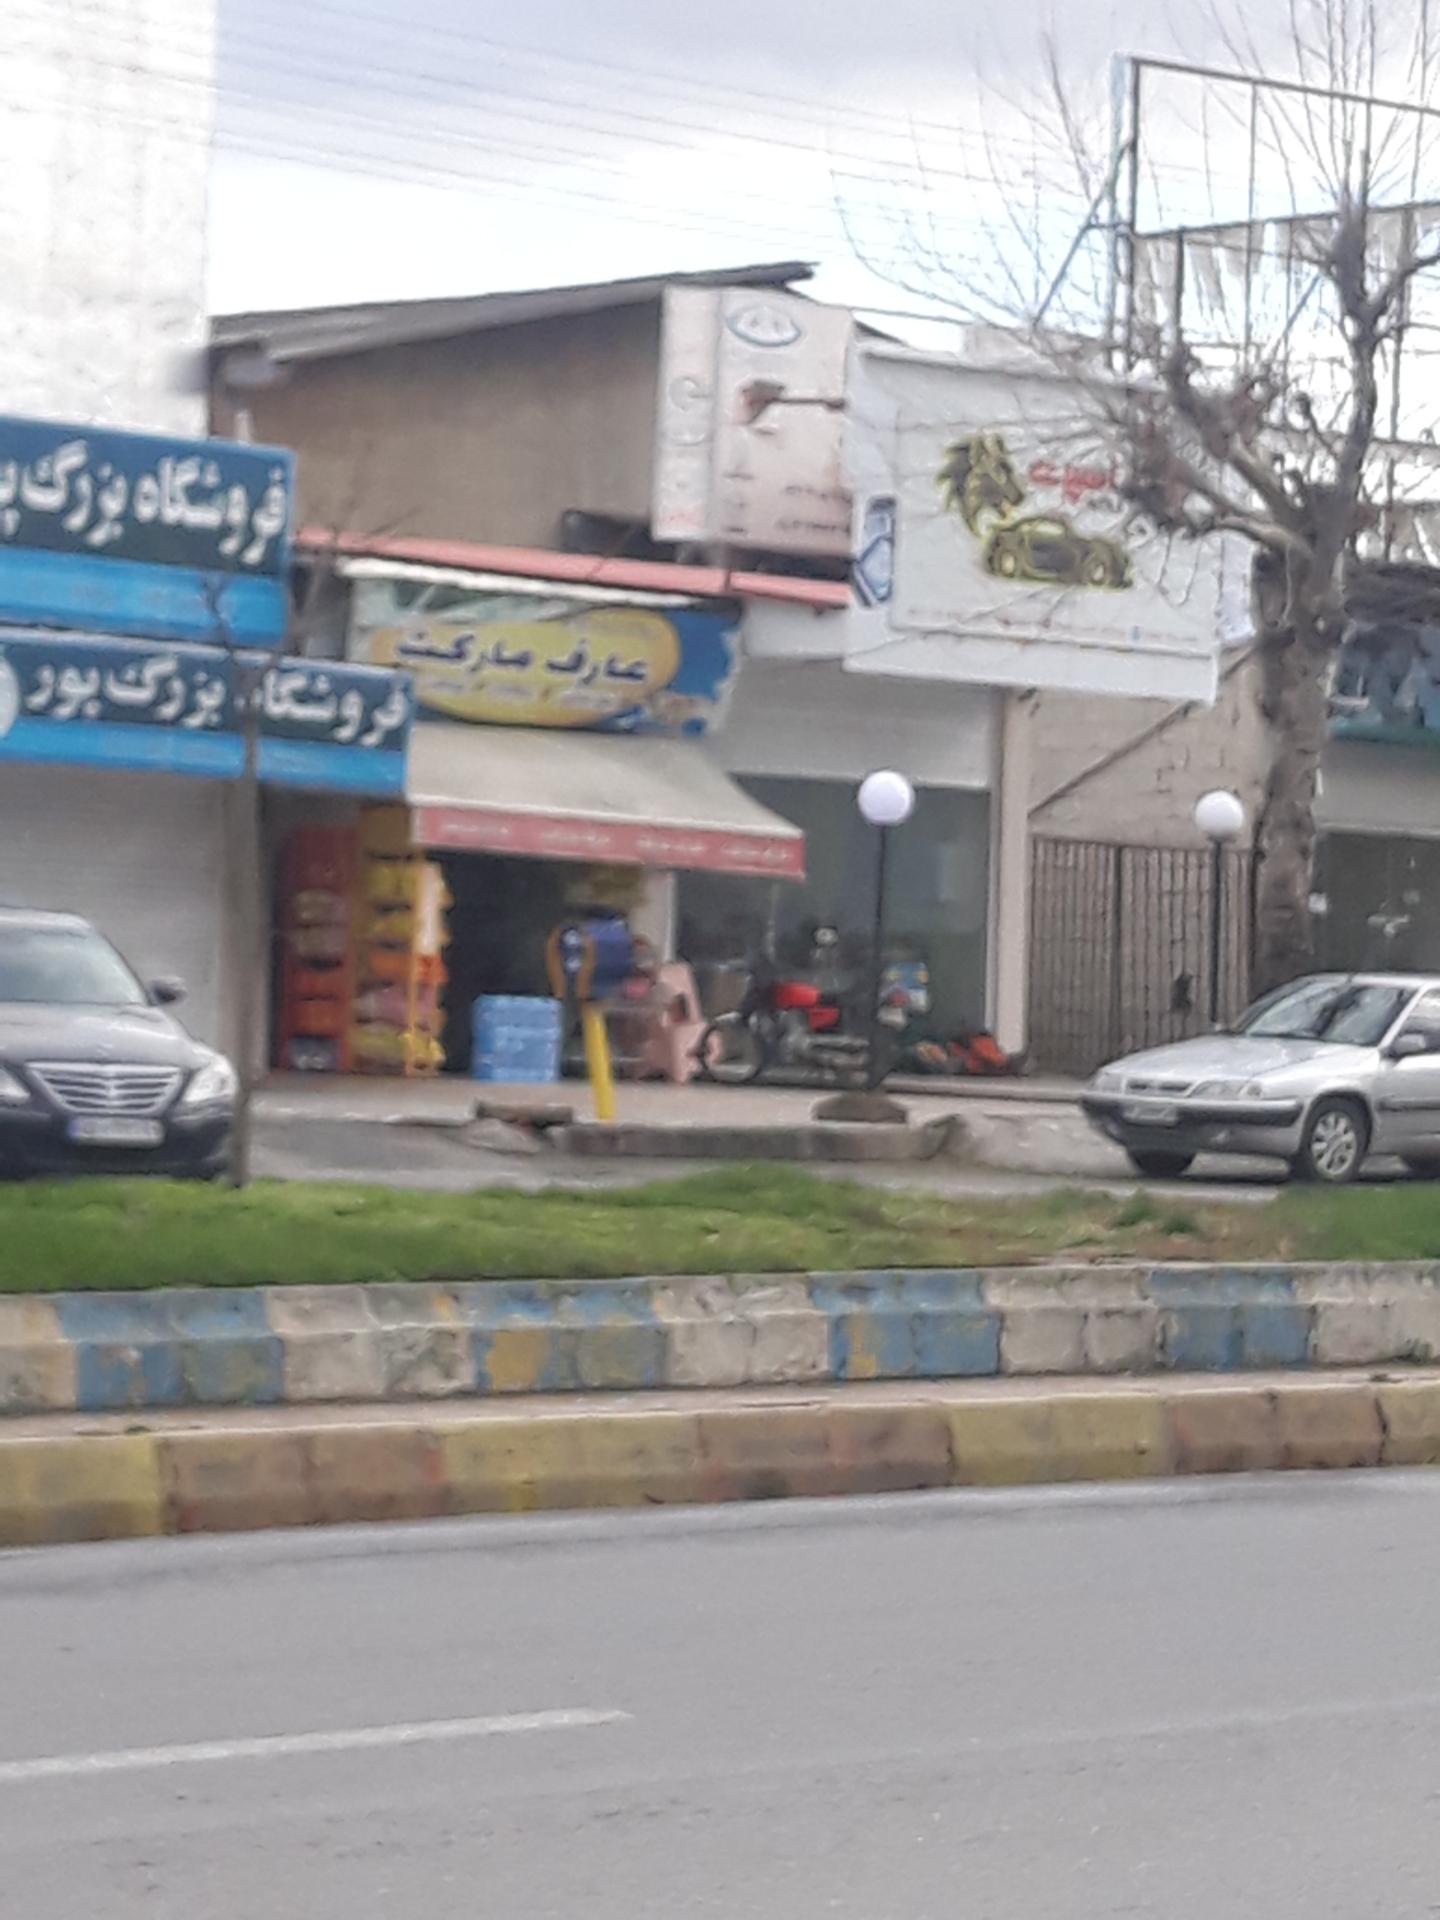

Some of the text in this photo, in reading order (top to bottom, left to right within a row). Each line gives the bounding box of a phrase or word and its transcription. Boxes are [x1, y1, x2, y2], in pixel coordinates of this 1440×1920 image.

[20, 438, 127, 546] بزرگ
[133, 455, 287, 565] فروشگاه
[104, 655, 227, 730] بزرگ
[397, 632, 648, 687] عارف مارکت
